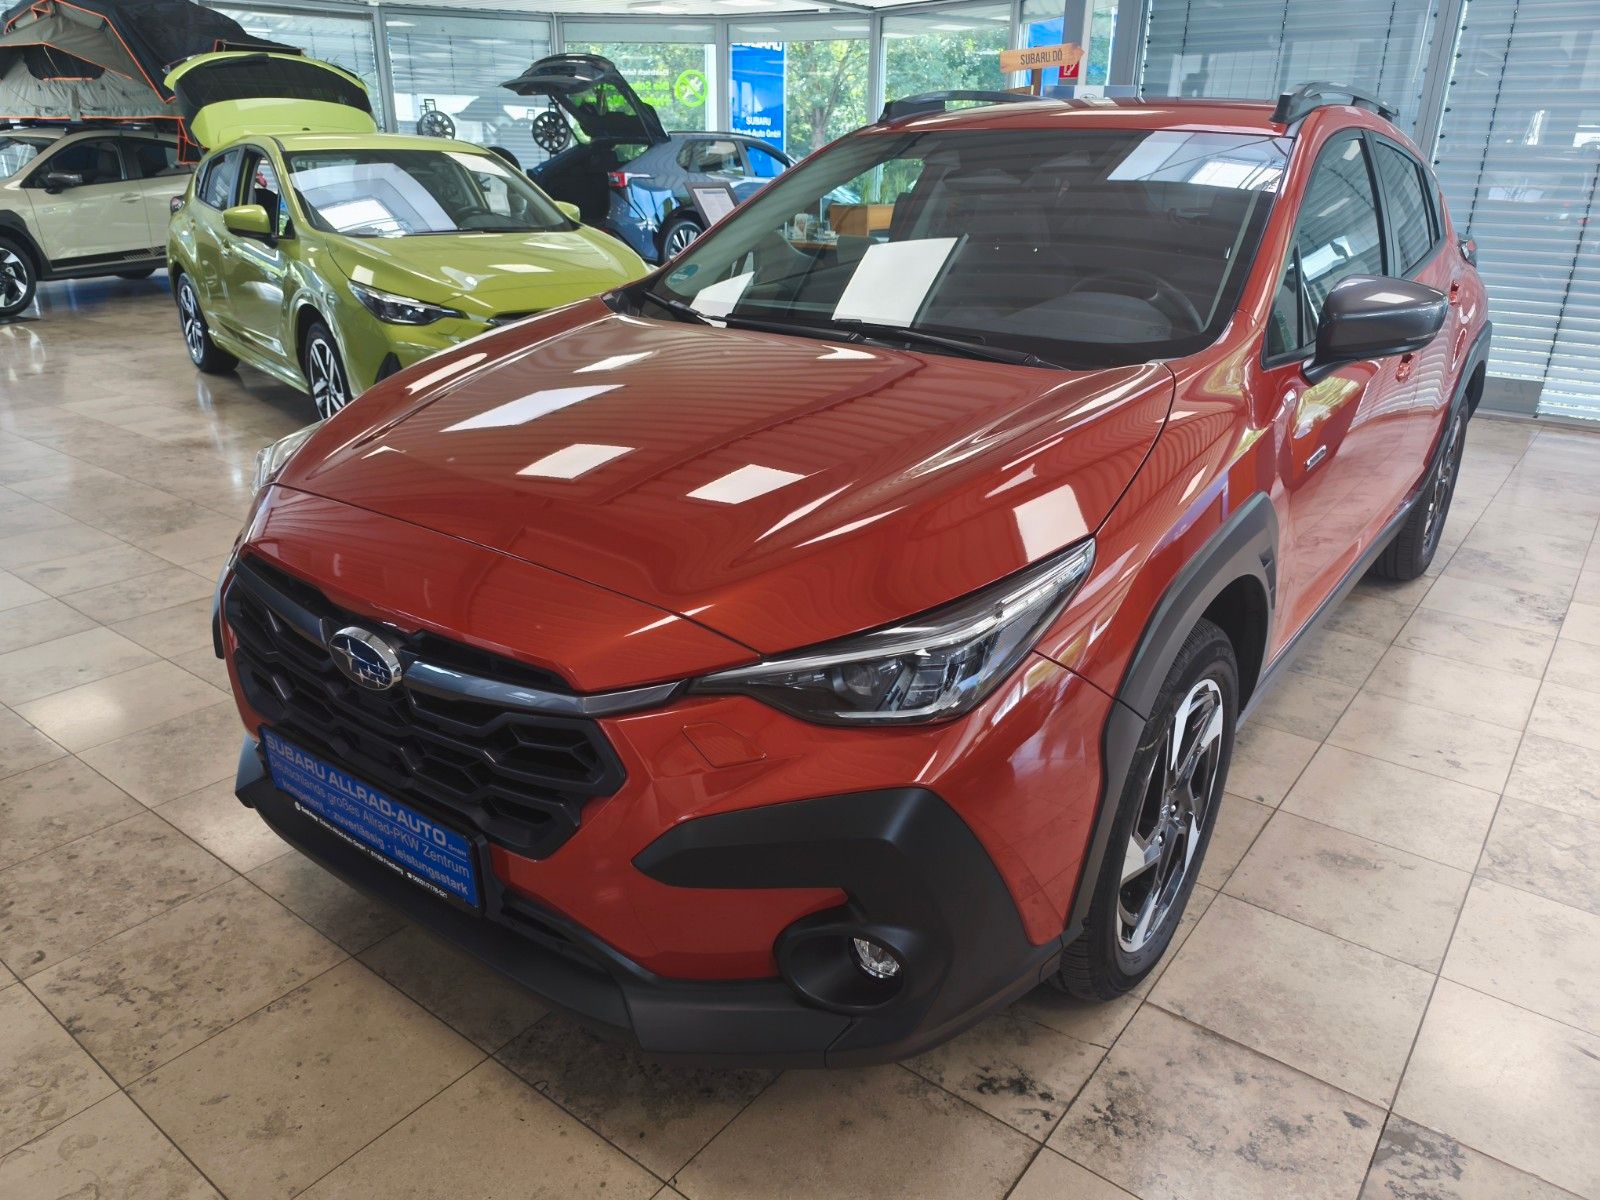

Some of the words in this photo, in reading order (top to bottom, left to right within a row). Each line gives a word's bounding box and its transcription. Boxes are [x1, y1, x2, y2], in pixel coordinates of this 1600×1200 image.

[1020, 51, 1051, 65] SUBARU
[746, 116, 772, 126] SUBARU
[265, 734, 326, 779] SUBARU
[329, 771, 447, 846] ALLRAD-AUTO
[363, 810, 419, 851] Allrad-PKW
[422, 842, 469, 877] Zentrum
[394, 846, 468, 895] leistungsstark
